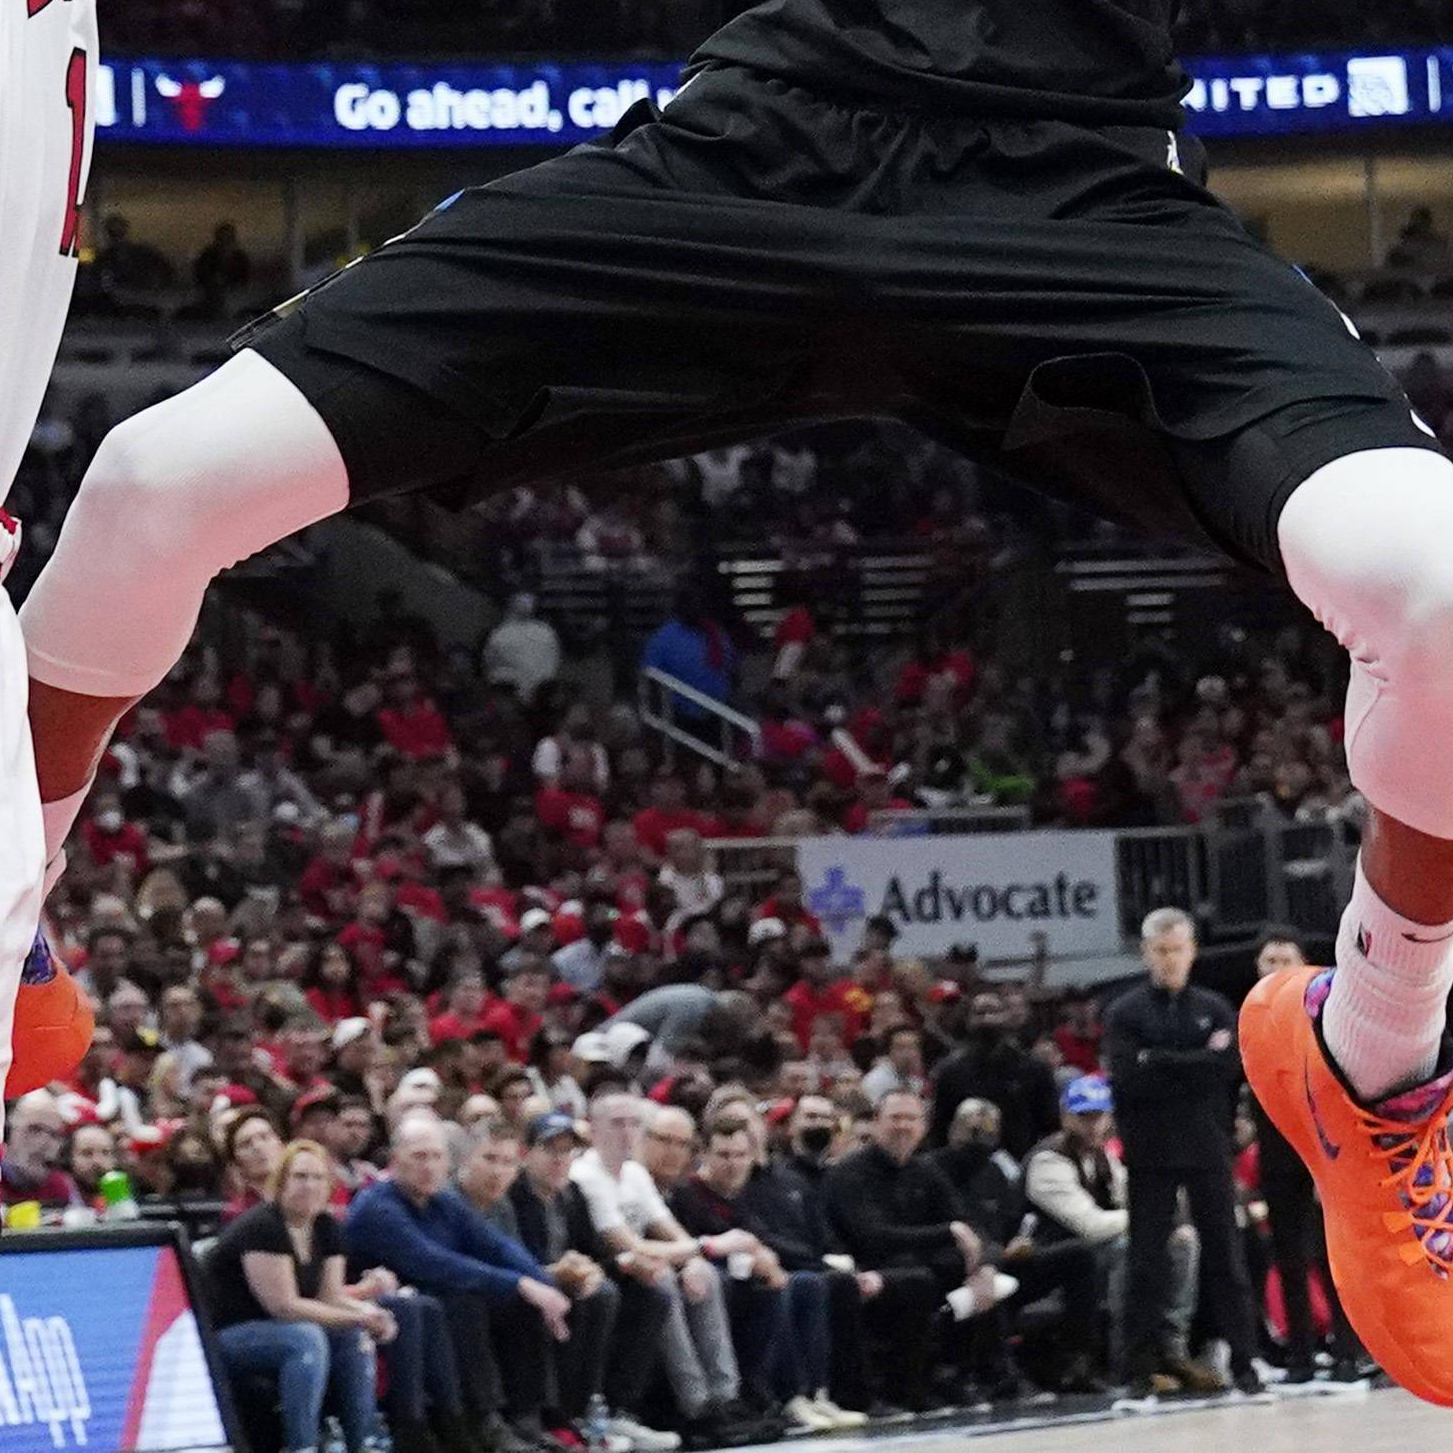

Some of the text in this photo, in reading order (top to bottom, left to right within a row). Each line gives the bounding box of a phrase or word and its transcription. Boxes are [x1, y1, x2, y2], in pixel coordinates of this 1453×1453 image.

[333, 80, 401, 130] Go
[405, 79, 564, 133] ahead,
[880, 866, 1099, 923] Advocate
